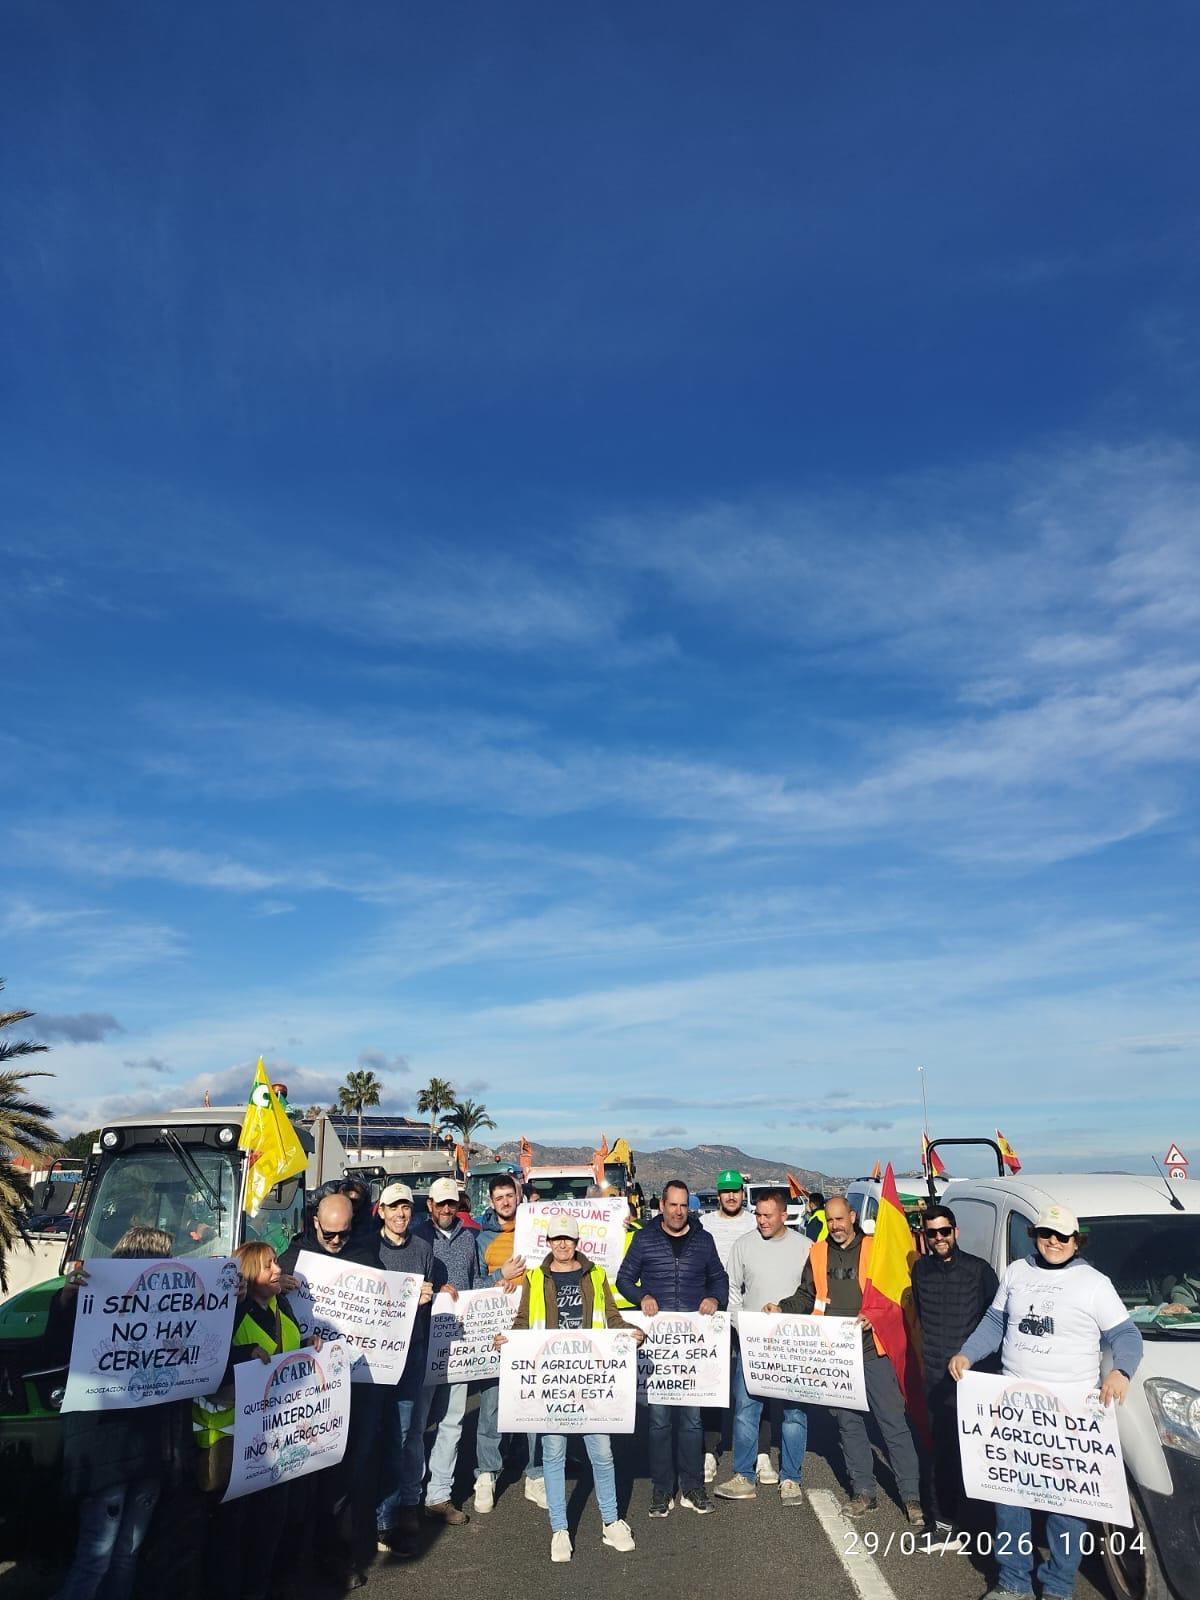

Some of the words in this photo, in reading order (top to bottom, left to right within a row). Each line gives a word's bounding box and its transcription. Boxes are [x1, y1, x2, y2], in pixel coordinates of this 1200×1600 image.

[541, 1206, 611, 1222] CONSUME
[533, 1218, 607, 1238] PRCTO
[136, 1272, 197, 1291] ACARM
[103, 1295, 149, 1314] SIN
[158, 1293, 229, 1312] CEBADA
[301, 1281, 314, 1290] NO
[316, 1284, 335, 1295] NOS
[338, 1290, 370, 1304] DEJAIS
[373, 1298, 407, 1308] TRABAJAR
[297, 1290, 336, 1306] NUESTRA
[341, 1301, 370, 1315] TIERRA
[381, 1310, 406, 1319] ENCIMA
[314, 1305, 362, 1324] RECORTAIS
[365, 1316, 375, 1325] LA
[377, 1318, 391, 1328] PAC
[112, 1323, 147, 1342] NO
[156, 1320, 197, 1340] HAY
[445, 1330, 459, 1338] QUE
[645, 1334, 705, 1344] NUESTRA
[381, 1340, 406, 1352] PAC!!
[638, 1349, 680, 1360] BREZA
[685, 1345, 717, 1360] SERÁ
[763, 1345, 784, 1353] DESDE
[800, 1348, 836, 1356] DESPACHO
[830, 1342, 855, 1350] CAMPO
[99, 1346, 200, 1371] CERVEZA!!
[431, 1361, 445, 1371] DE
[449, 1356, 486, 1369] CAMPO
[511, 1360, 536, 1370] SIN
[541, 1360, 627, 1370] AGRICULTURA
[271, 1359, 316, 1387] ACARM
[521, 1374, 537, 1384] NI
[542, 1371, 616, 1384] GANADERÍA
[637, 1364, 697, 1375] VUESTRA
[637, 1379, 696, 1390] HAMBRE!!
[751, 1371, 828, 1388] BUROCRÁTICA
[244, 1395, 282, 1415] QUIEREN
[285, 1390, 301, 1403] QUE
[305, 1379, 342, 1397] COMAMOS
[520, 1389, 535, 1399] LA
[541, 1389, 576, 1399] MESA
[581, 1386, 614, 1399] ESTÁ
[990, 1404, 1024, 1421] HOY
[1033, 1411, 1057, 1427] EN
[1065, 1416, 1101, 1433] DIA
[272, 1439, 280, 1451] A
[284, 1416, 343, 1447] MERCOSUR!!
[962, 1420, 982, 1436] LA
[990, 1426, 1117, 1457] AGRICULTURA
[985, 1444, 1007, 1460] ES
[1014, 1449, 1102, 1475] NUESTRA
[988, 1467, 1101, 1497] SEPULTURA!!
